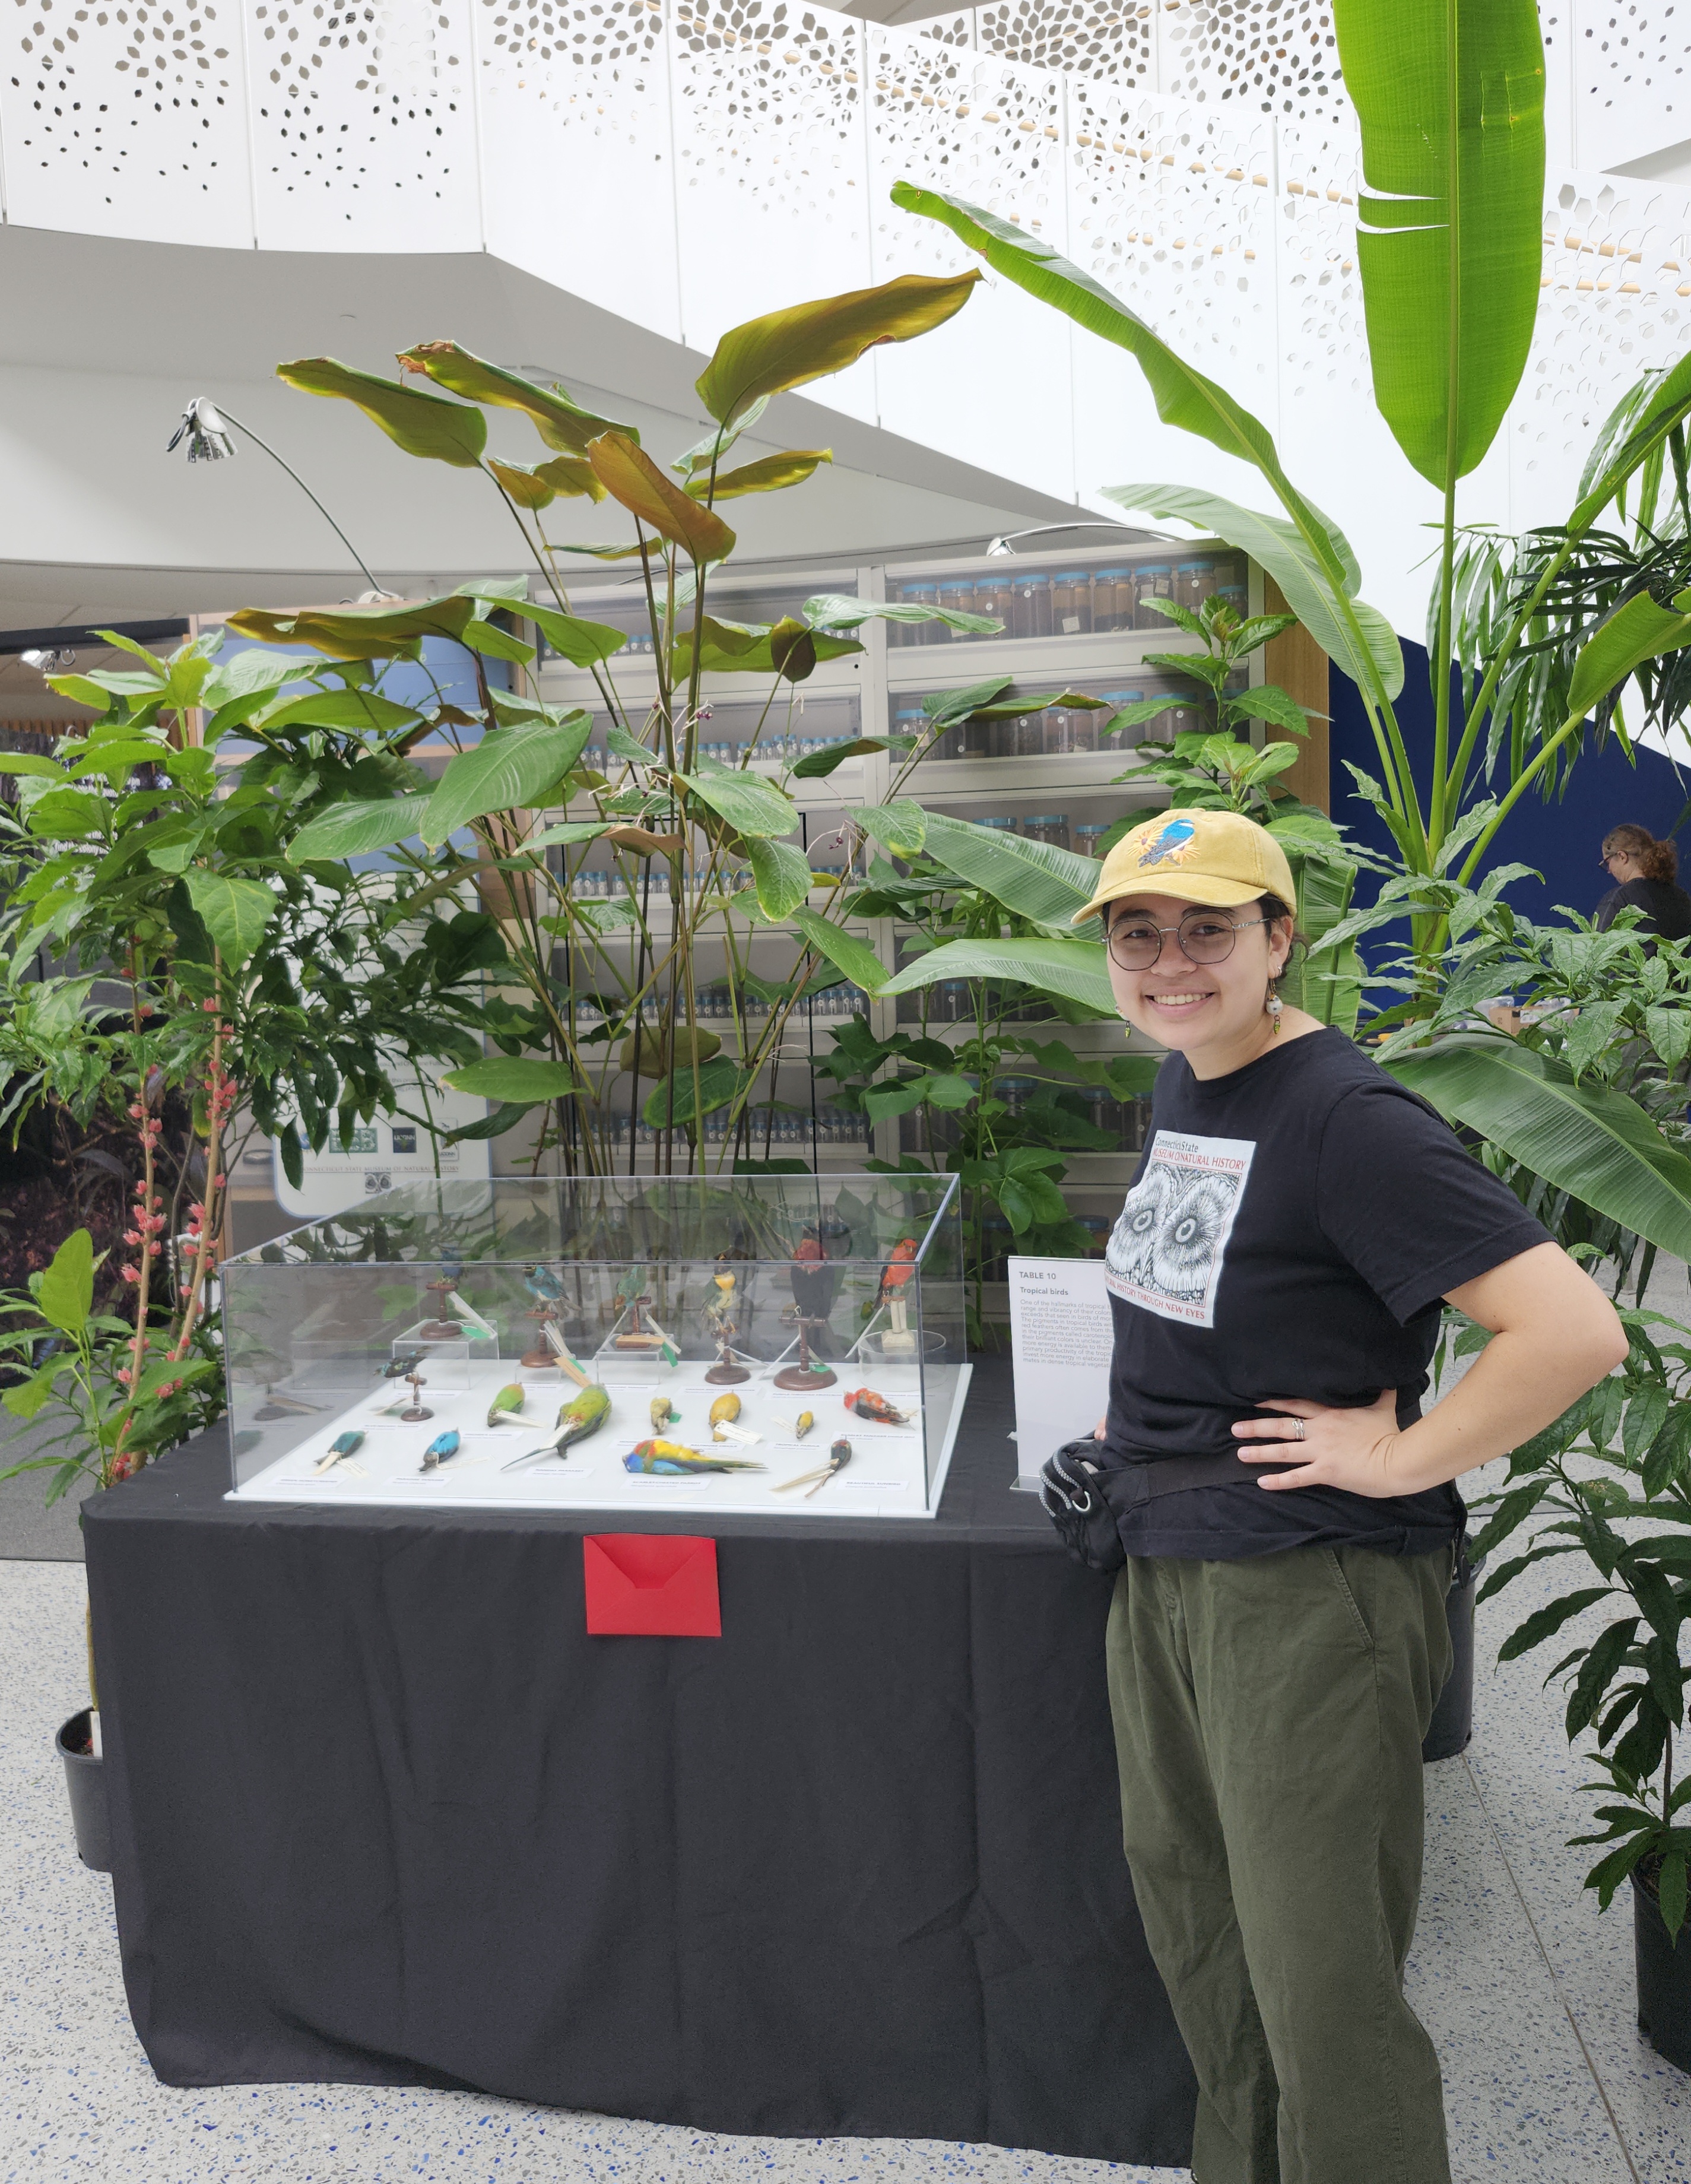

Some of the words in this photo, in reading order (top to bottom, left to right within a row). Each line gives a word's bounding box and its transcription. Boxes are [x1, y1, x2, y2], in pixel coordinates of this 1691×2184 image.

[1155, 1137, 1181, 1150] Connectic
[1181, 1141, 1198, 1153] State
[1175, 1152, 1180, 1160] O
[1180, 1153, 1210, 1166] NATURAL
[1212, 1157, 1246, 1170] HISTORY
[1117, 1282, 1136, 1298] HISTORY
[1137, 1292, 1163, 1308] THROUGH
[1165, 1302, 1182, 1314] NEW
[1186, 1308, 1205, 1319] EYES
[1045, 1347, 1077, 1355] productivity
